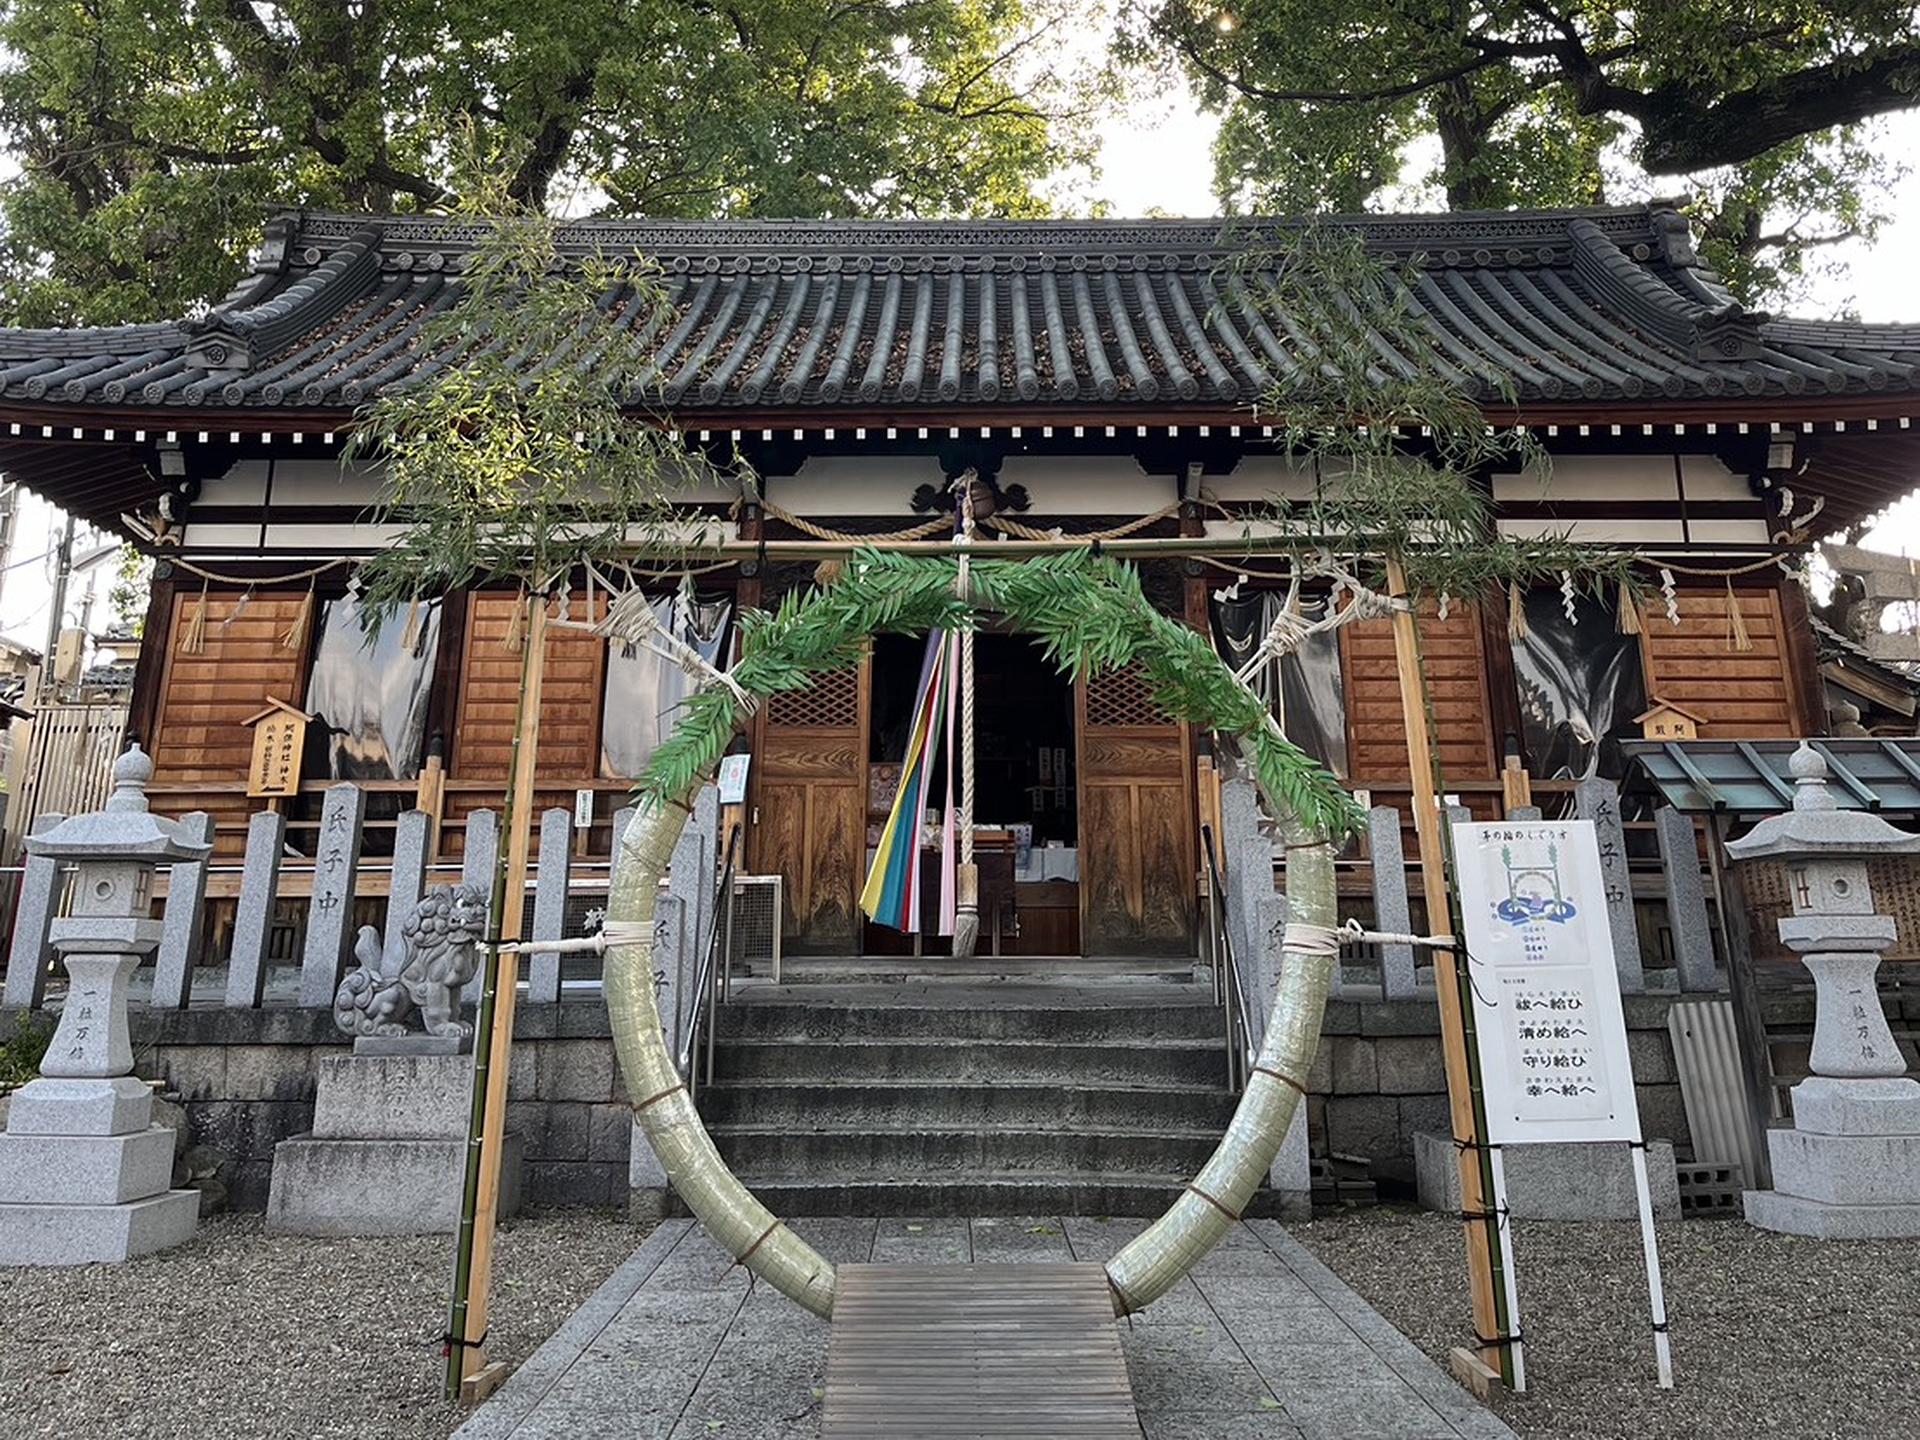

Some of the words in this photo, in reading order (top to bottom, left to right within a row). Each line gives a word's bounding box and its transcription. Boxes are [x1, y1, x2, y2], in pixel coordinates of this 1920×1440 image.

[1595, 798, 1625, 912] 氏子中
[317, 804, 348, 920] 氏子中
[1519, 1026, 1588, 1039] 清め給へ
[1522, 1055, 1587, 1068] 守り給ひ
[1526, 1084, 1596, 1097] 幸へ給へ
